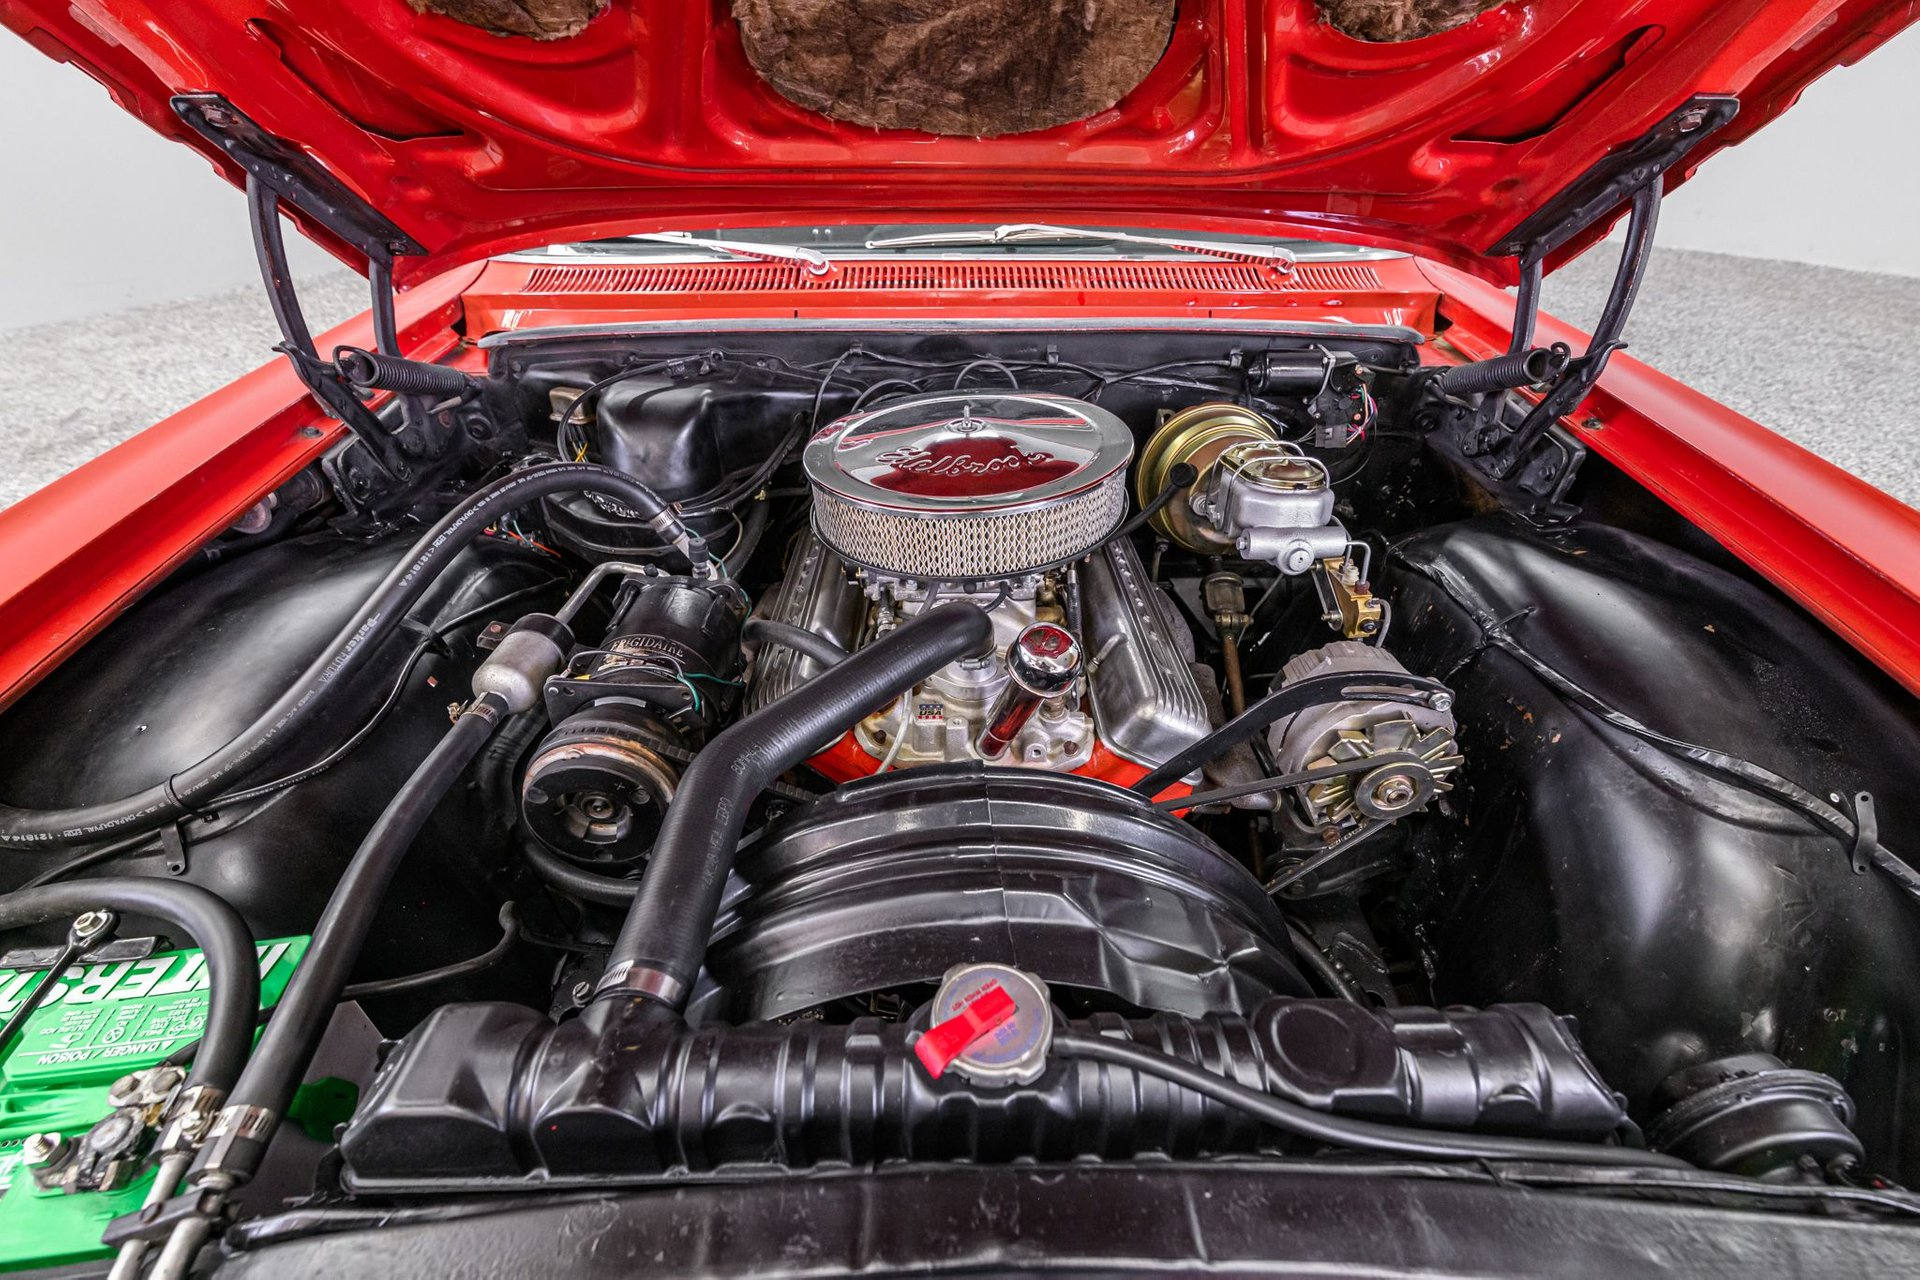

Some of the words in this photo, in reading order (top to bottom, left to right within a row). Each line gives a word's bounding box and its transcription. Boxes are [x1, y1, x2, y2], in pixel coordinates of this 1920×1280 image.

[609, 637, 683, 657] FRIGIDAIRE
[101, 1041, 159, 1057] DANGER
[36, 1050, 92, 1065] POISON
